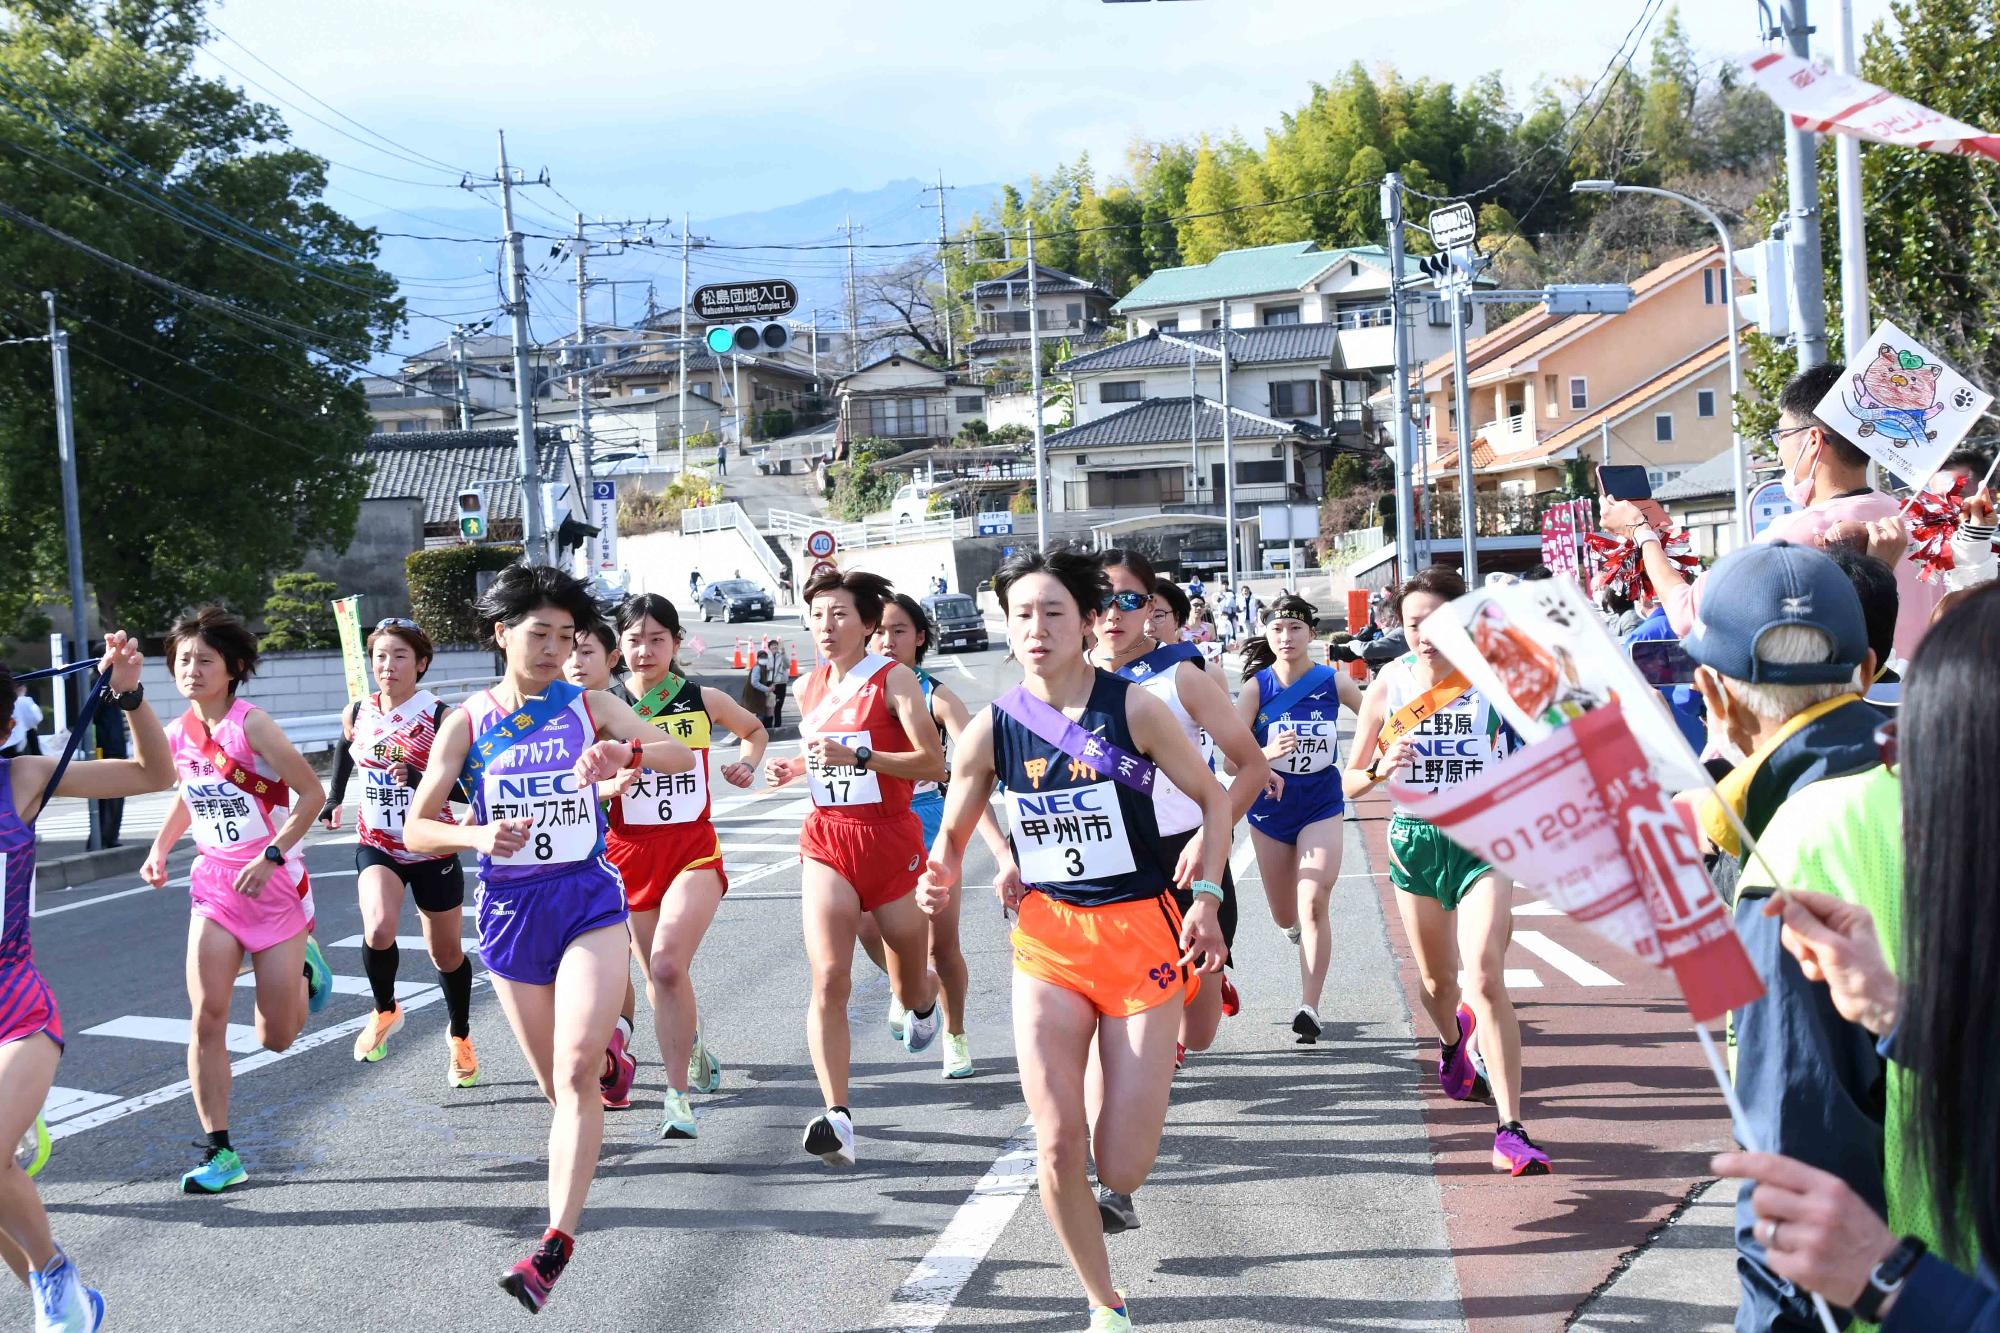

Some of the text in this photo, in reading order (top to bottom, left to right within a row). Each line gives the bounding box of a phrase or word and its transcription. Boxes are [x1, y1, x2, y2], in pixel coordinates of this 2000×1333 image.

[701, 285, 787, 306] 松島団地入口
[735, 304, 756, 312] Housing
[757, 302, 780, 311] Complex
[814, 538, 829, 551] 40
[1279, 723, 1328, 737] NEC
[1413, 713, 1473, 736] 上野原
[374, 744, 405, 763] 甲斐
[500, 737, 570, 769] 南アルプス
[1408, 738, 1479, 757] NEC
[1023, 756, 1098, 790] 甲州
[1288, 756, 1312, 773] 12
[1404, 758, 1484, 784] 上野原市
[186, 781, 238, 798] NEC
[365, 786, 409, 807] 甲斐市
[498, 772, 580, 799] NEC
[630, 773, 696, 800] 大月市
[825, 780, 850, 803] 17
[191, 796, 251, 820] 南都留郡
[657, 799, 673, 822] 6
[1017, 788, 1104, 816] NEC
[382, 808, 406, 827] 11
[214, 820, 241, 843] 16
[1020, 814, 1113, 846] 甲州市
[534, 832, 553, 861] 8
[1064, 847, 1085, 877] 3
